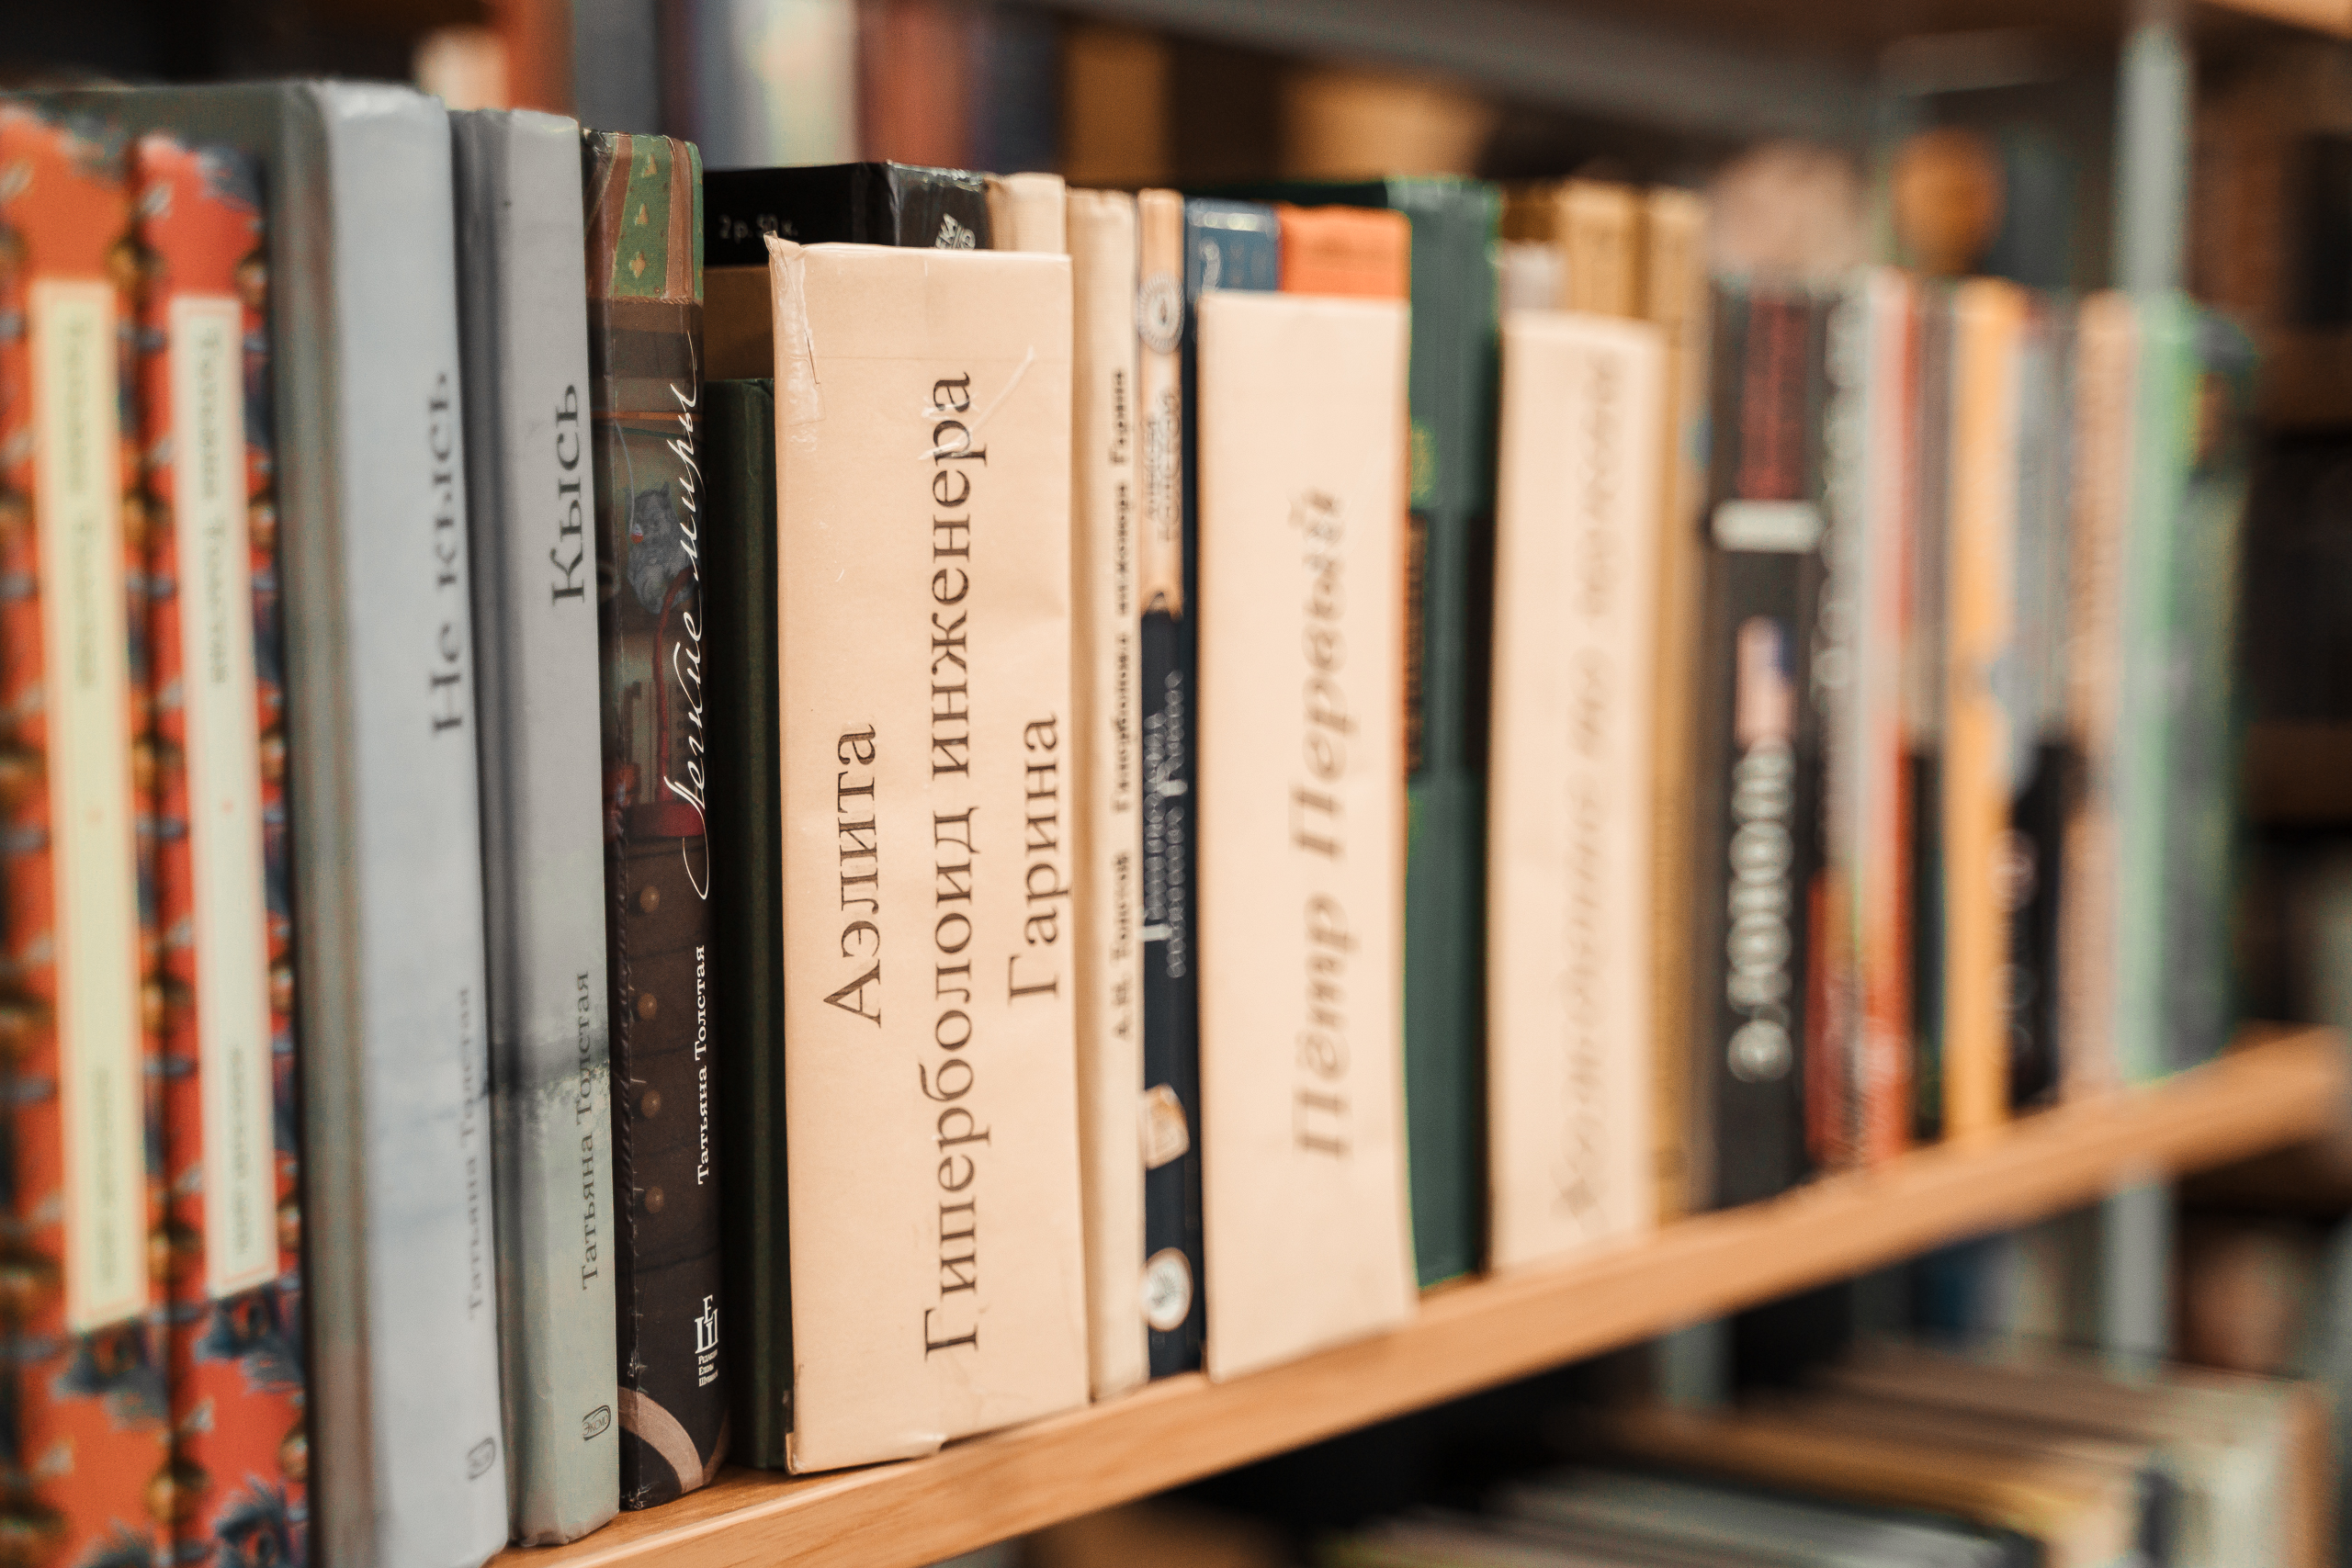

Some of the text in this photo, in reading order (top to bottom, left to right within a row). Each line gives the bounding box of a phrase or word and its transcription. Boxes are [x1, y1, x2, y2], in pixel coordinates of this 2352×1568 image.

[428, 371, 462, 736] Не кысь
[550, 383, 585, 604] Кысь
[667, 331, 706, 581] миры
[823, 723, 882, 1029] Аэлита
[918, 371, 991, 1362] Гиперболоид инженера
[1008, 711, 1071, 1008] Гарина
[576, 971, 599, 1291] Татьяна Толстая
[695, 944, 709, 1185] Татьяна Толстая
